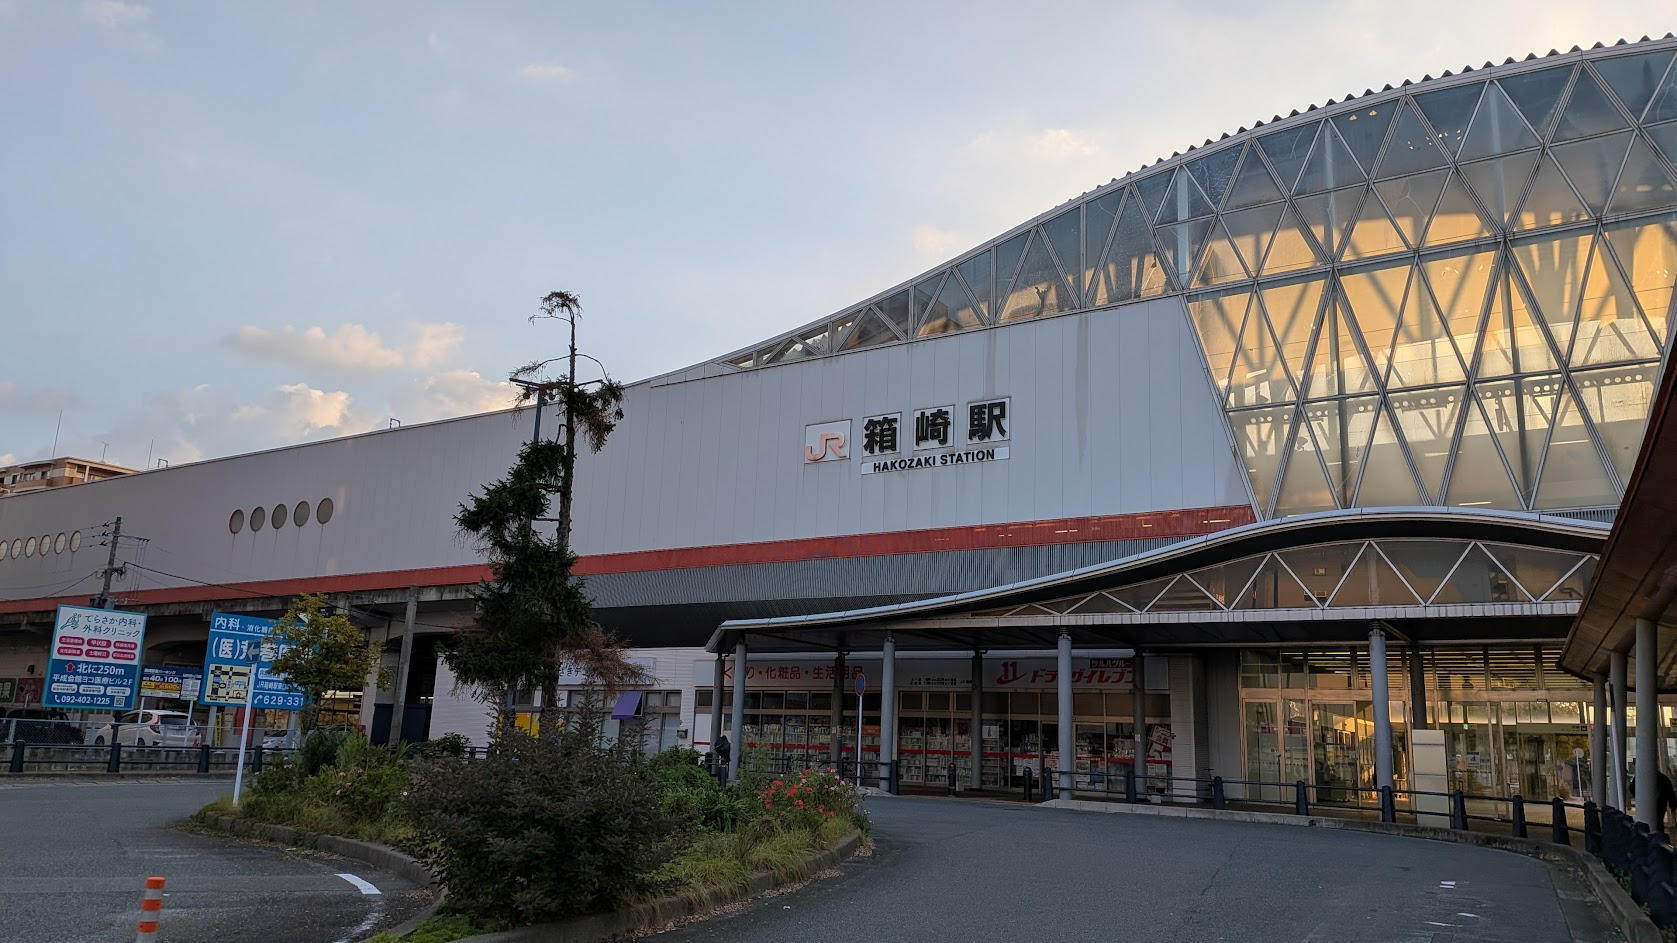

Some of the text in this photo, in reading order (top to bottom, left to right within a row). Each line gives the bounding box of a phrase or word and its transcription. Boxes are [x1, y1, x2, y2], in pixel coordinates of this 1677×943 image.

[805, 401, 1007, 462] JR 箱崎駅
[873, 449, 995, 473] HAKOZAKI STATION
[82, 625, 140, 638] 外科クリニック
[77, 663, 125, 675] 北に250m
[1091, 659, 1133, 668] ツルハグルー
[724, 666, 863, 680] くり・化粧品・生活用品
[1031, 668, 1134, 684] ドラグイレブ
[61, 696, 110, 705] 092-402-1225
